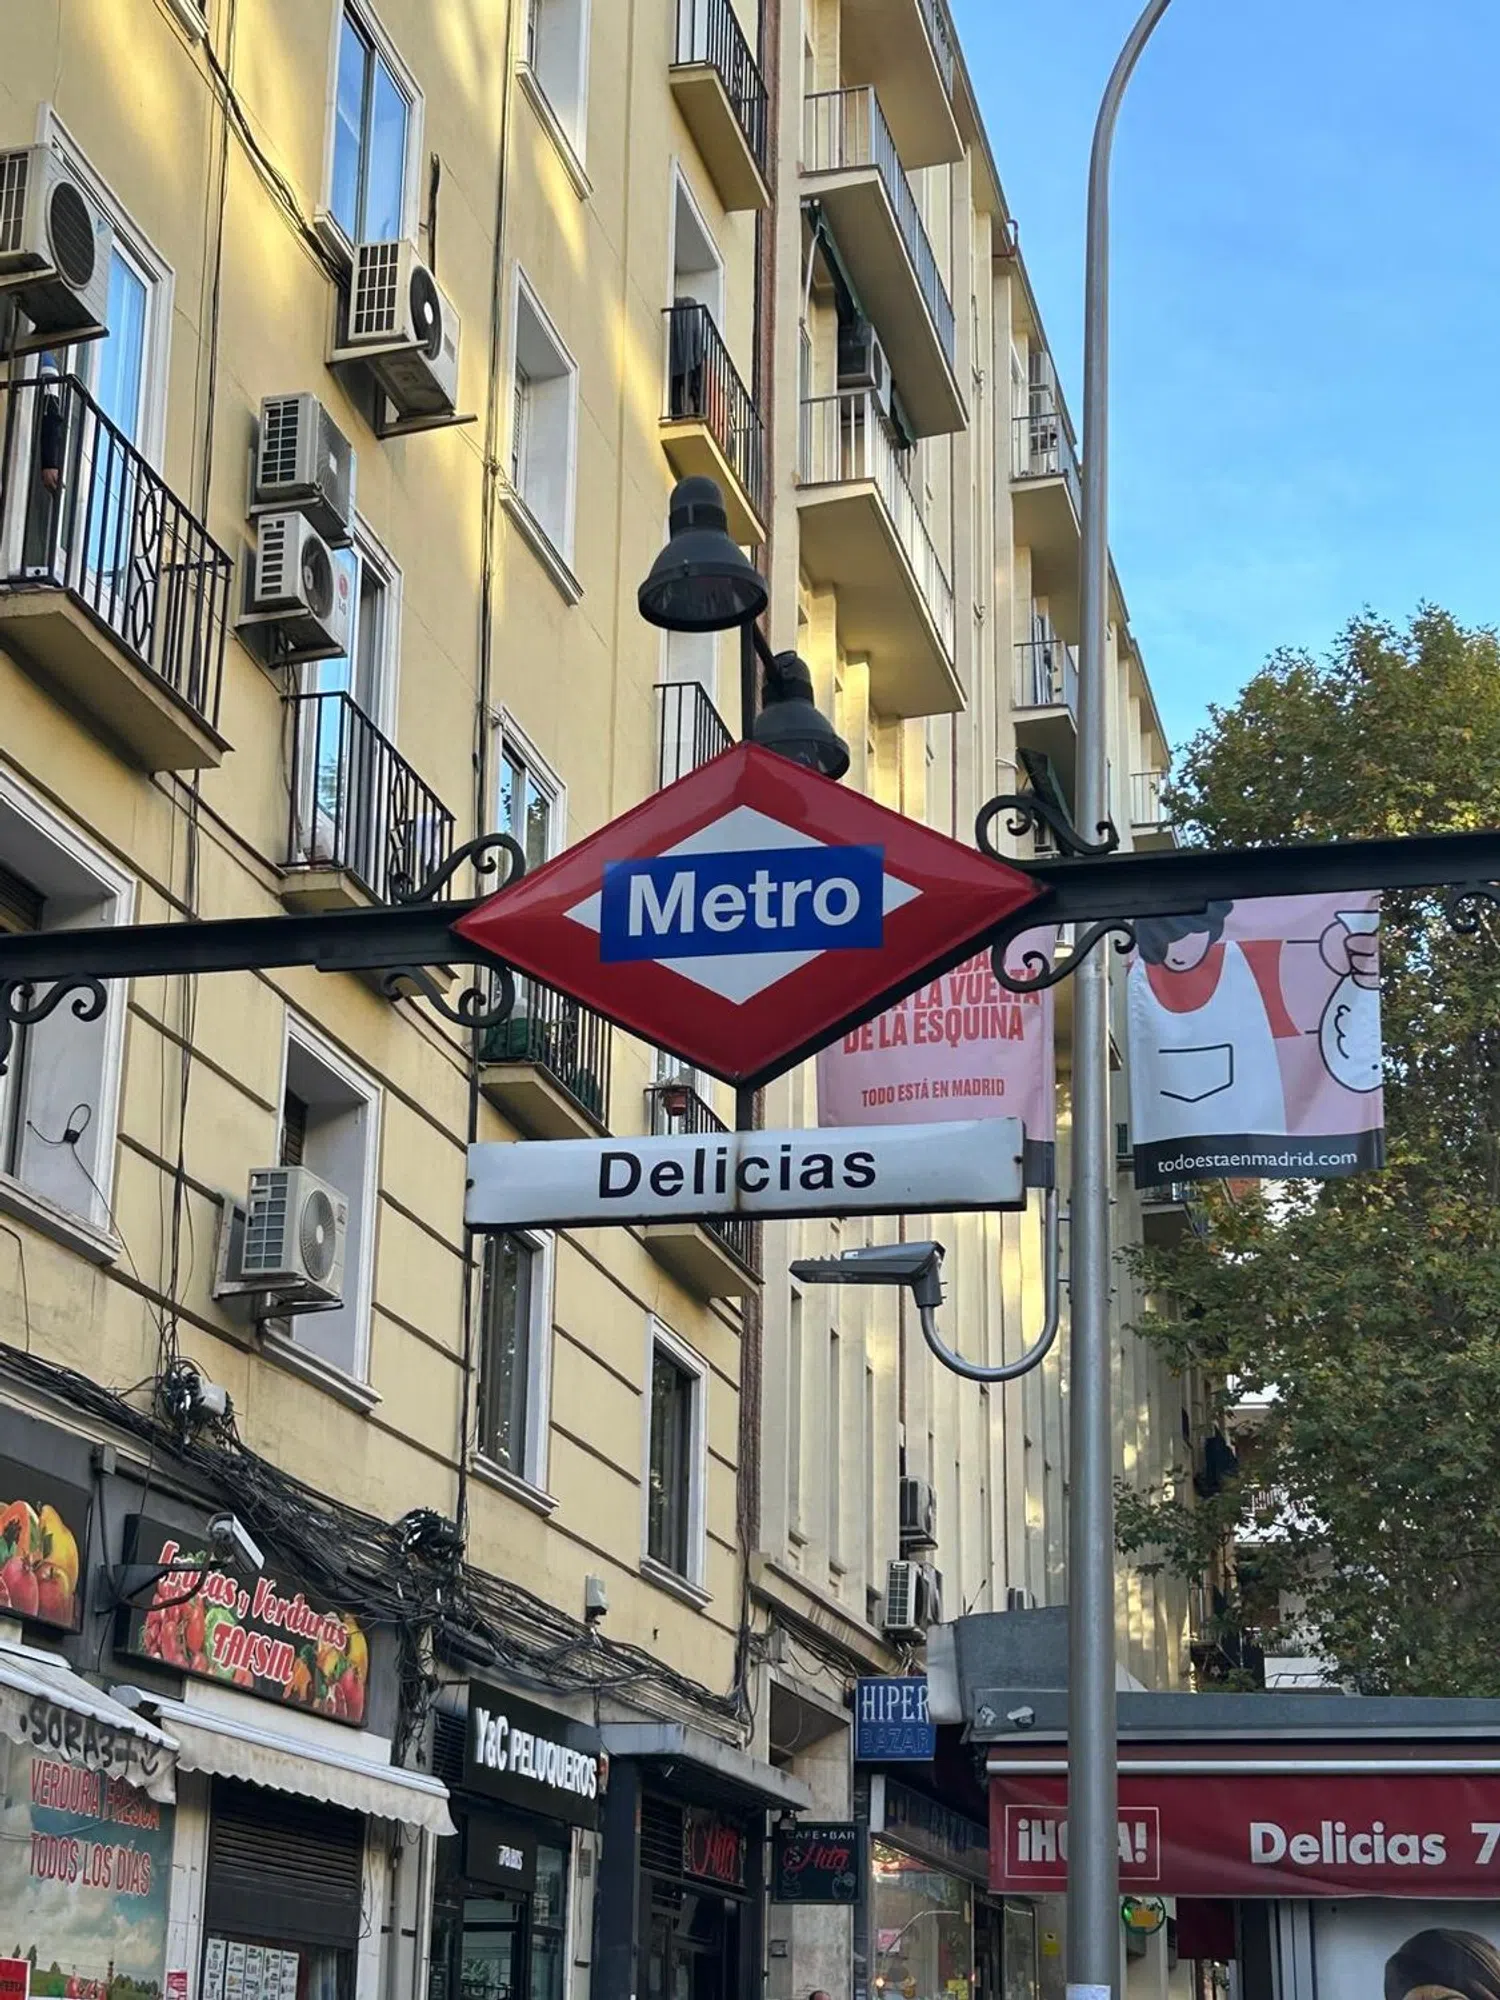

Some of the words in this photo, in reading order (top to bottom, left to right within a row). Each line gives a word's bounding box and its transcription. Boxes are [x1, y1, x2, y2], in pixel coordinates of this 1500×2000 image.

[628, 870, 860, 937] Metro
[879, 1012, 908, 1049] LA
[914, 1006, 1024, 1048] ESQUINA
[861, 1086, 895, 1107] TODO
[898, 1078, 930, 1101] ESTÁ
[932, 1079, 949, 1098] EN
[952, 1077, 1005, 1097] MADRID
[599, 1145, 877, 1200] Delicias
[1158, 1151, 1357, 1173] todoestaenmadrid.com
[236, 1589, 250, 1620] y
[252, 1576, 349, 1651] Verduras
[476, 1707, 508, 1772] Y&C
[510, 1728, 597, 1799] PELUQUEROS
[861, 1727, 930, 1753] BAZAR
[31, 1758, 100, 1819] VERDURA
[829, 1829, 855, 1840] BAR
[1250, 1821, 1446, 1865] Delicias
[1471, 1822, 1500, 1864] 7
[31, 1832, 79, 1883] TODOS
[82, 1840, 112, 1889] LOS
[116, 1840, 151, 1896] DÍAS
